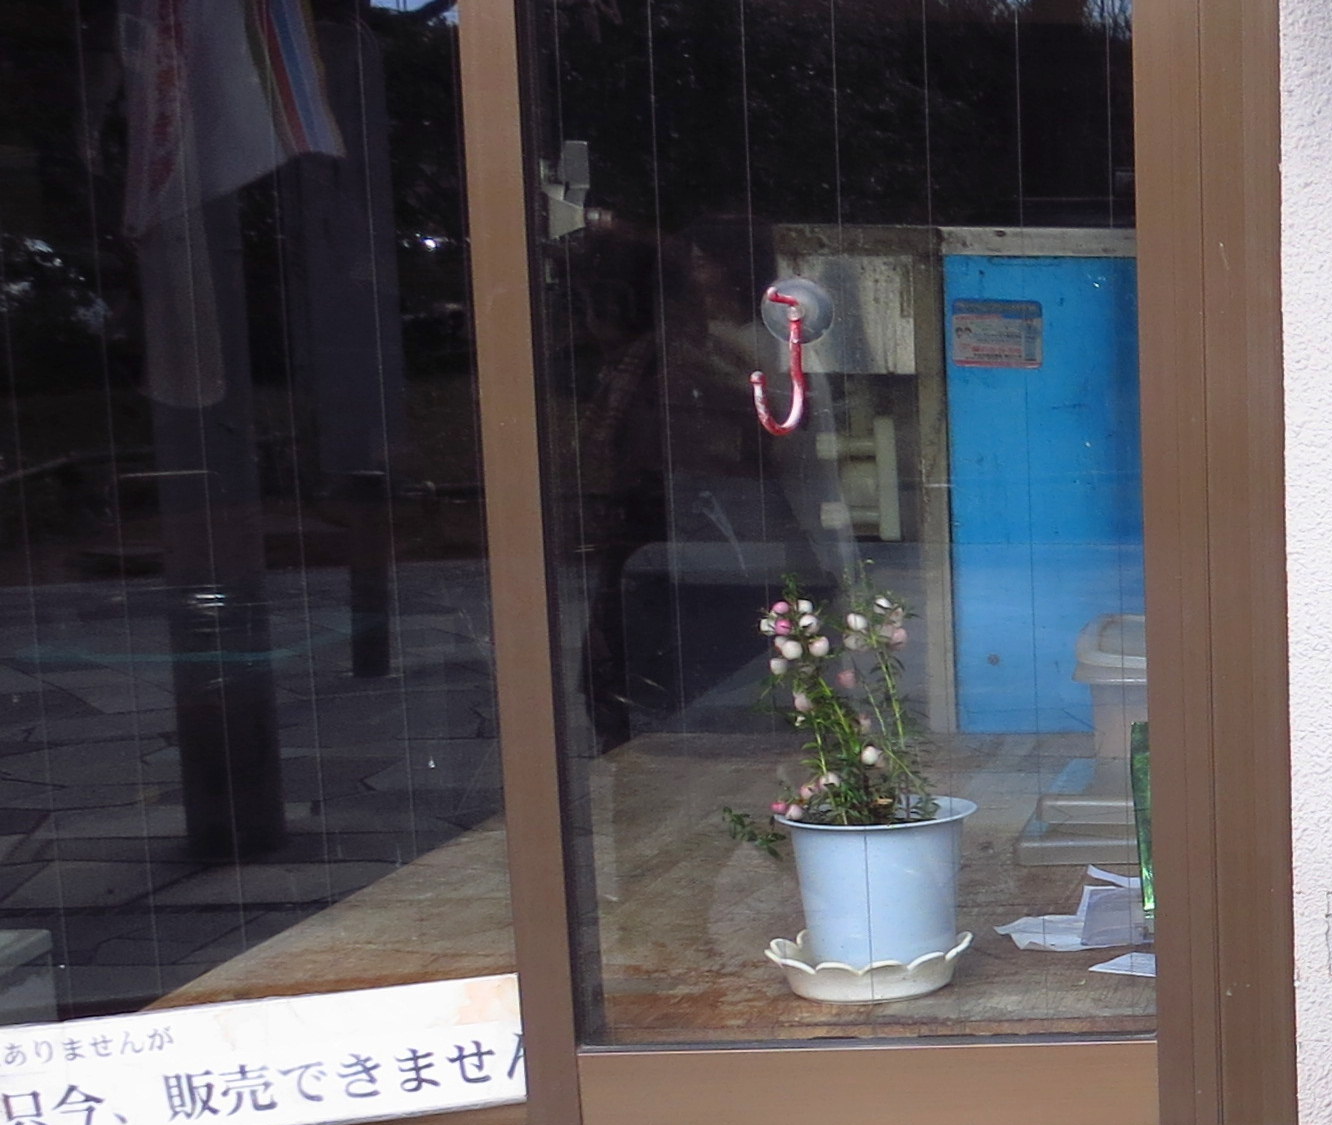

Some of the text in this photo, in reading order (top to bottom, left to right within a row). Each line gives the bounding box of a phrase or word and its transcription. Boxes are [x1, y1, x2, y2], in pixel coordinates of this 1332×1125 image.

[4, 1026, 174, 1066] ありませんが
